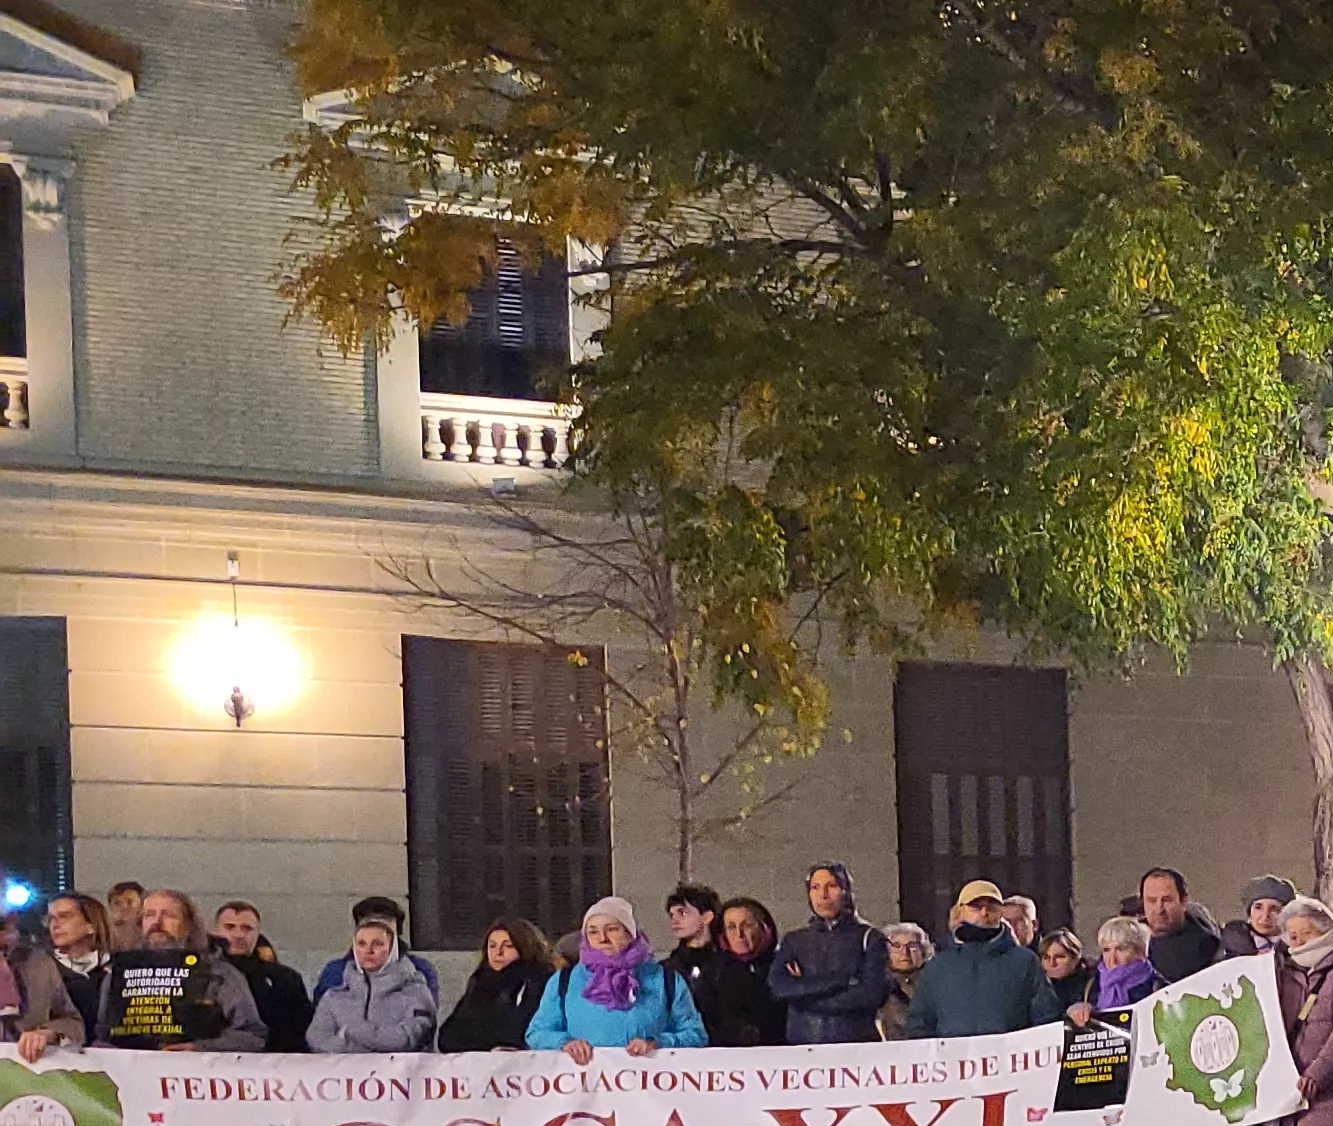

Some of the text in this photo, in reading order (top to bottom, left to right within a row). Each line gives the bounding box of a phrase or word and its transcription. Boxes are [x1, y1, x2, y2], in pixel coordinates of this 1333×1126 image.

[124, 968, 190, 978] QUIERO QUE LAS
[126, 978, 181, 987] AUTORIDADES
[122, 987, 183, 997] GARANTICEN LA
[159, 1070, 411, 1102] FEDERACIÓN
[423, 1075, 475, 1100] DE
[481, 1068, 746, 1100] ASOCIACIONES
[756, 1059, 948, 1092] VECINALES
[959, 1055, 999, 1082] DE
